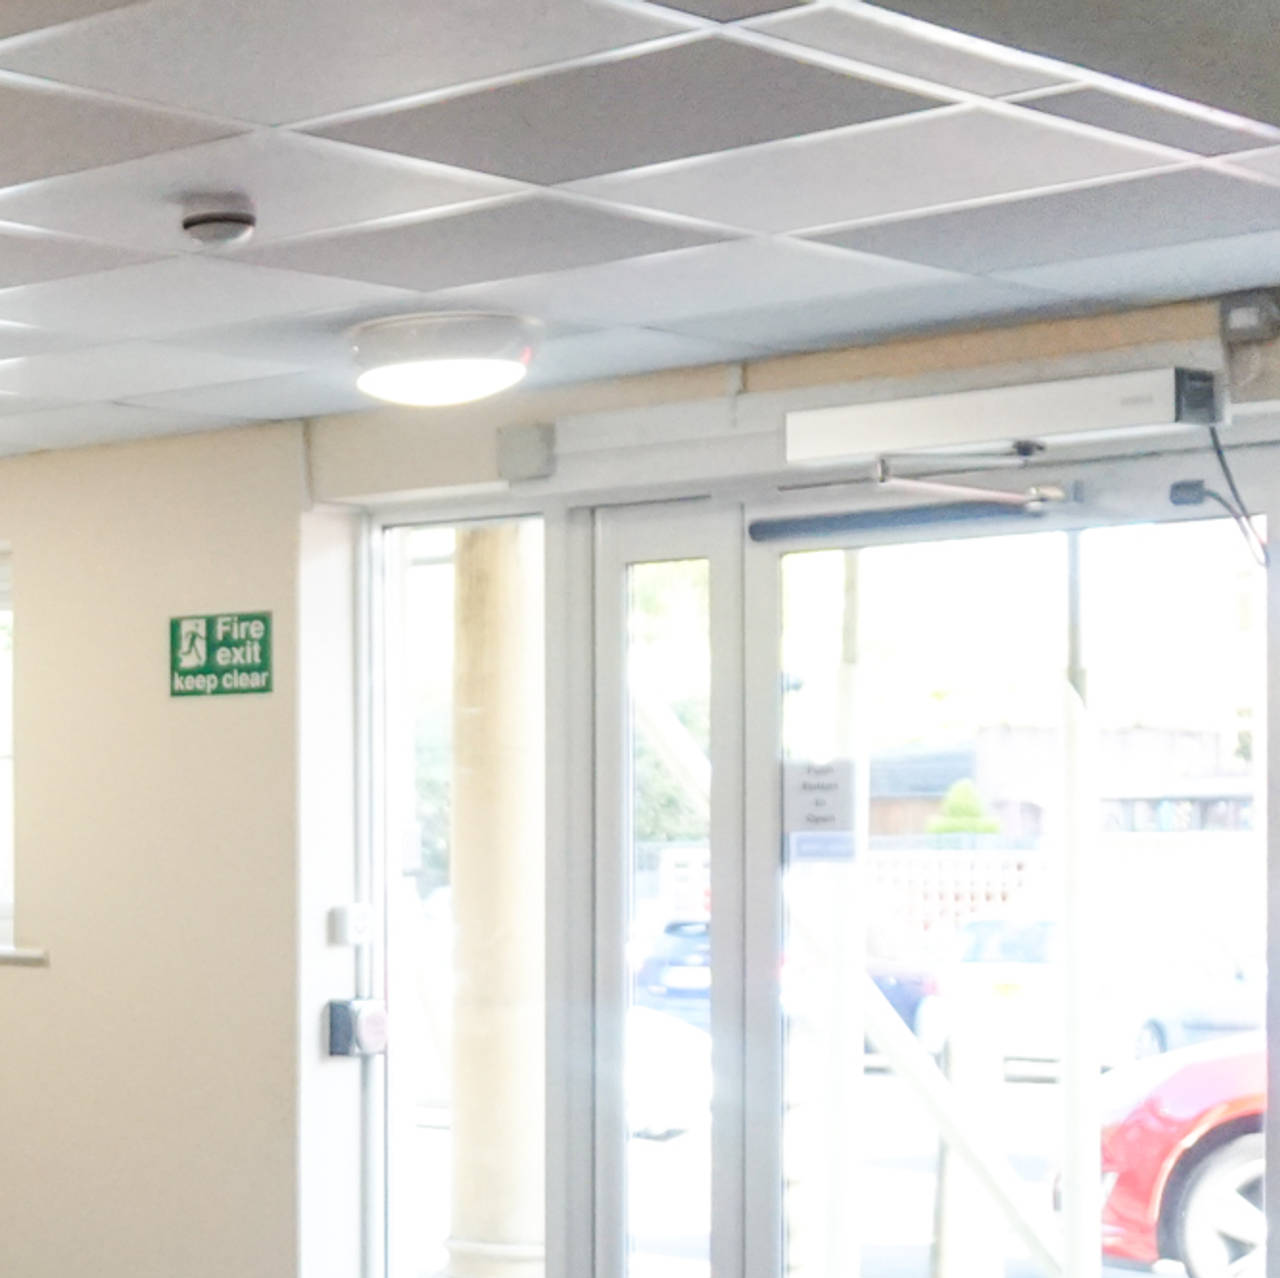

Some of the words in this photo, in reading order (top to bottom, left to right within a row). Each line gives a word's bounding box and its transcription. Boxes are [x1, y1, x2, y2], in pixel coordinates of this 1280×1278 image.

[216, 616, 265, 641] Fire
[216, 641, 261, 666] exit
[174, 671, 218, 694] keep
[222, 668, 269, 689] clear
